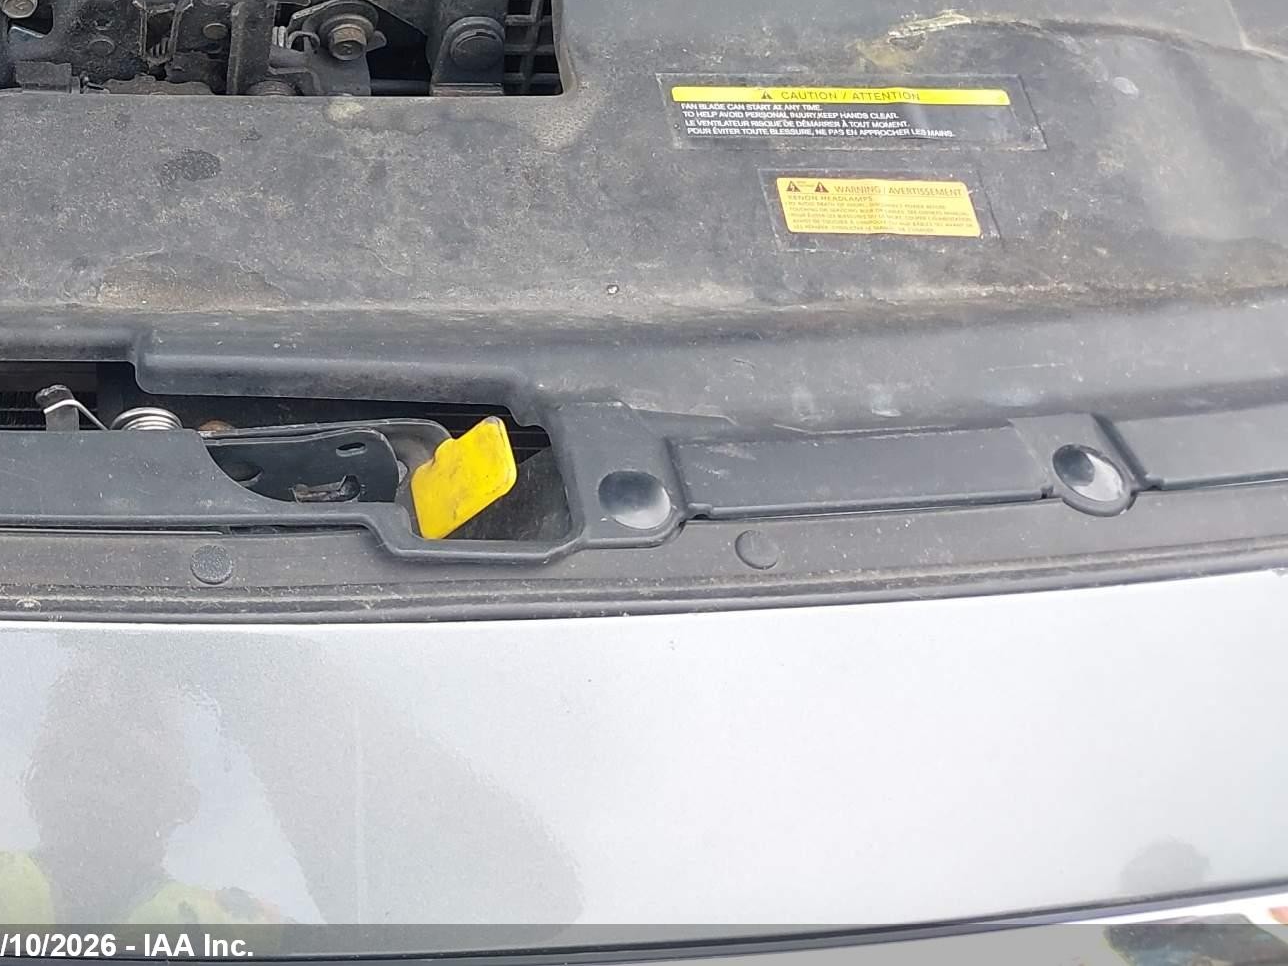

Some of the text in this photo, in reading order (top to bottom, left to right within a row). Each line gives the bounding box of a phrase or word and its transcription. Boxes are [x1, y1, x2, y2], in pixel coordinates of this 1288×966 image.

[781, 91, 837, 100] CAUTION
[852, 92, 920, 101] ATTENTION
[727, 103, 745, 111] CAN
[745, 111, 789, 119] PERSONAL
[870, 112, 899, 120] CLEAR.
[752, 120, 783, 128] RISQUE
[834, 185, 881, 194] WARNING
[889, 186, 962, 197] AVERTISSEMENT
